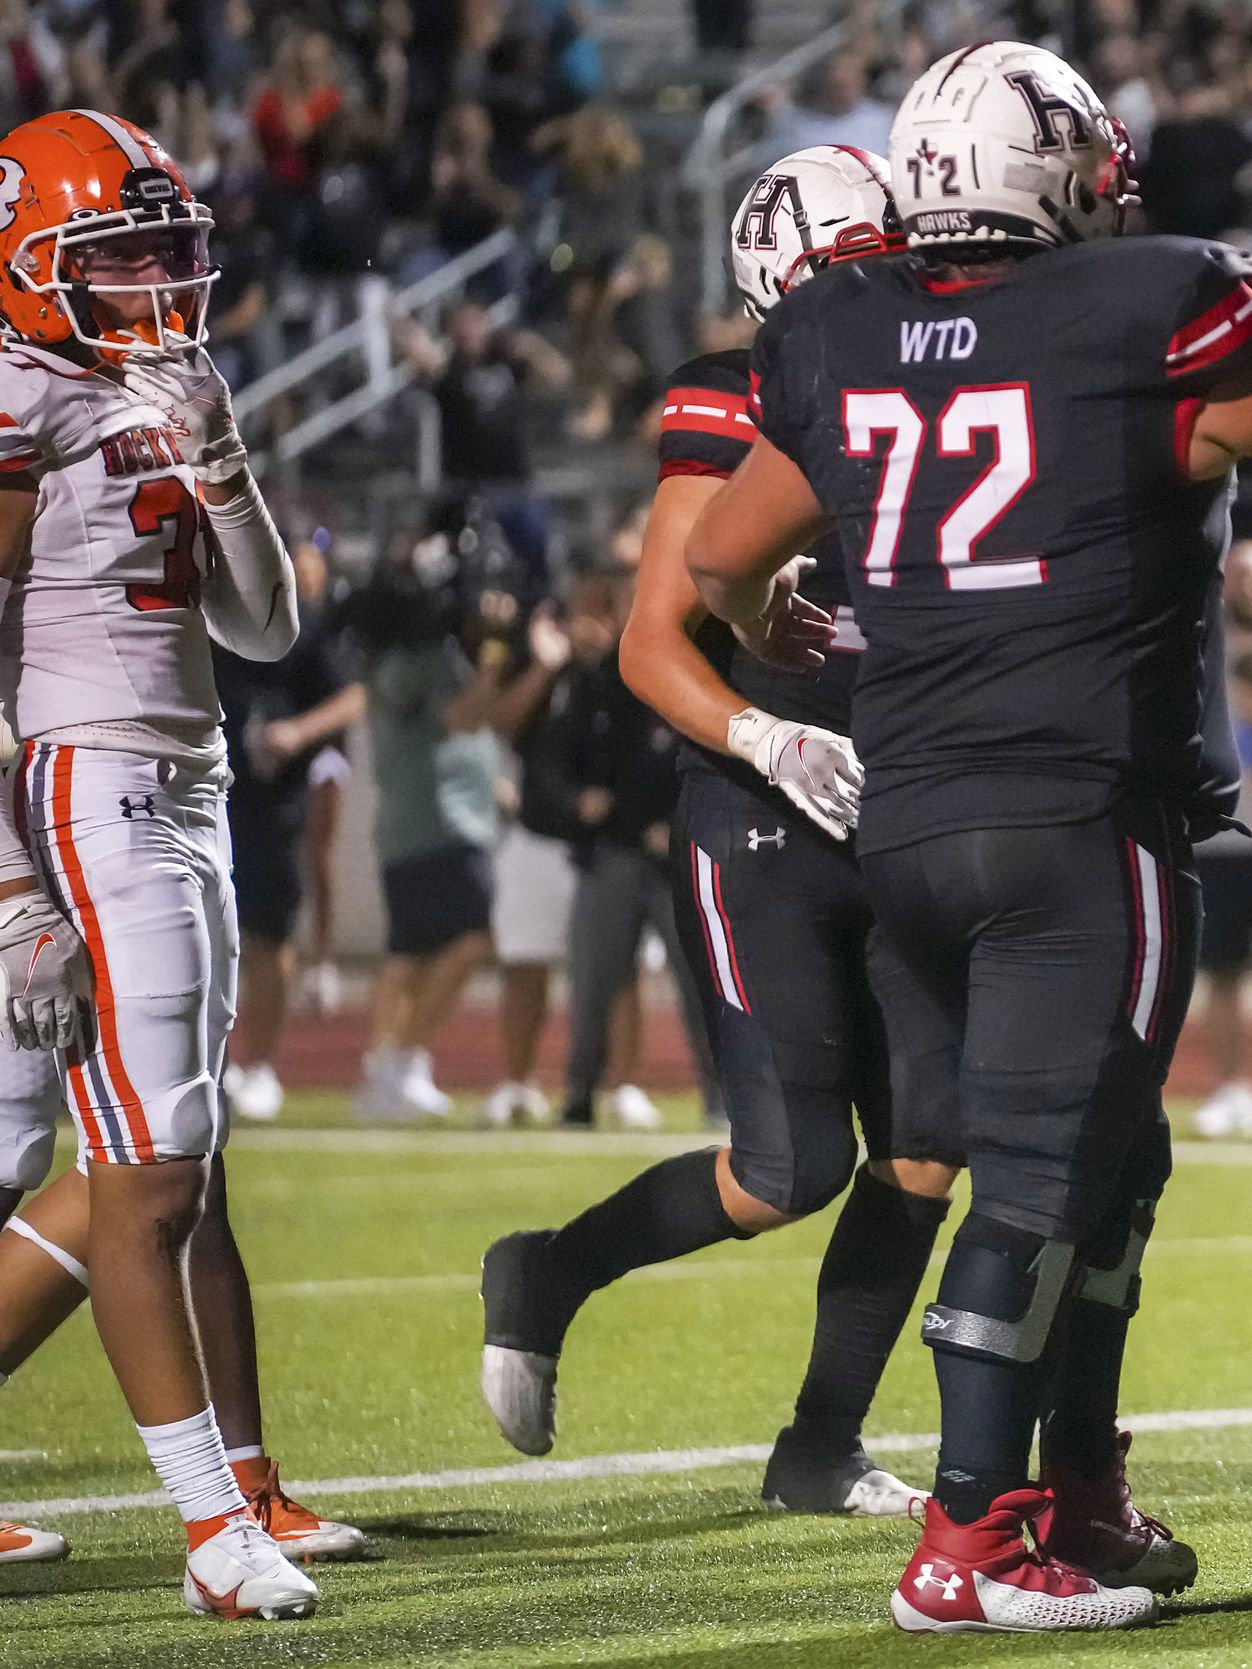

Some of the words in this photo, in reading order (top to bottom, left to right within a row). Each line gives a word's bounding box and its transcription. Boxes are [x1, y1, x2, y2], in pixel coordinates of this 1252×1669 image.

[906, 154, 961, 199] 72
[735, 174, 797, 251] H
[917, 211, 972, 233] HAWKS
[900, 316, 978, 363] WTD
[841, 381, 1048, 590] 72
